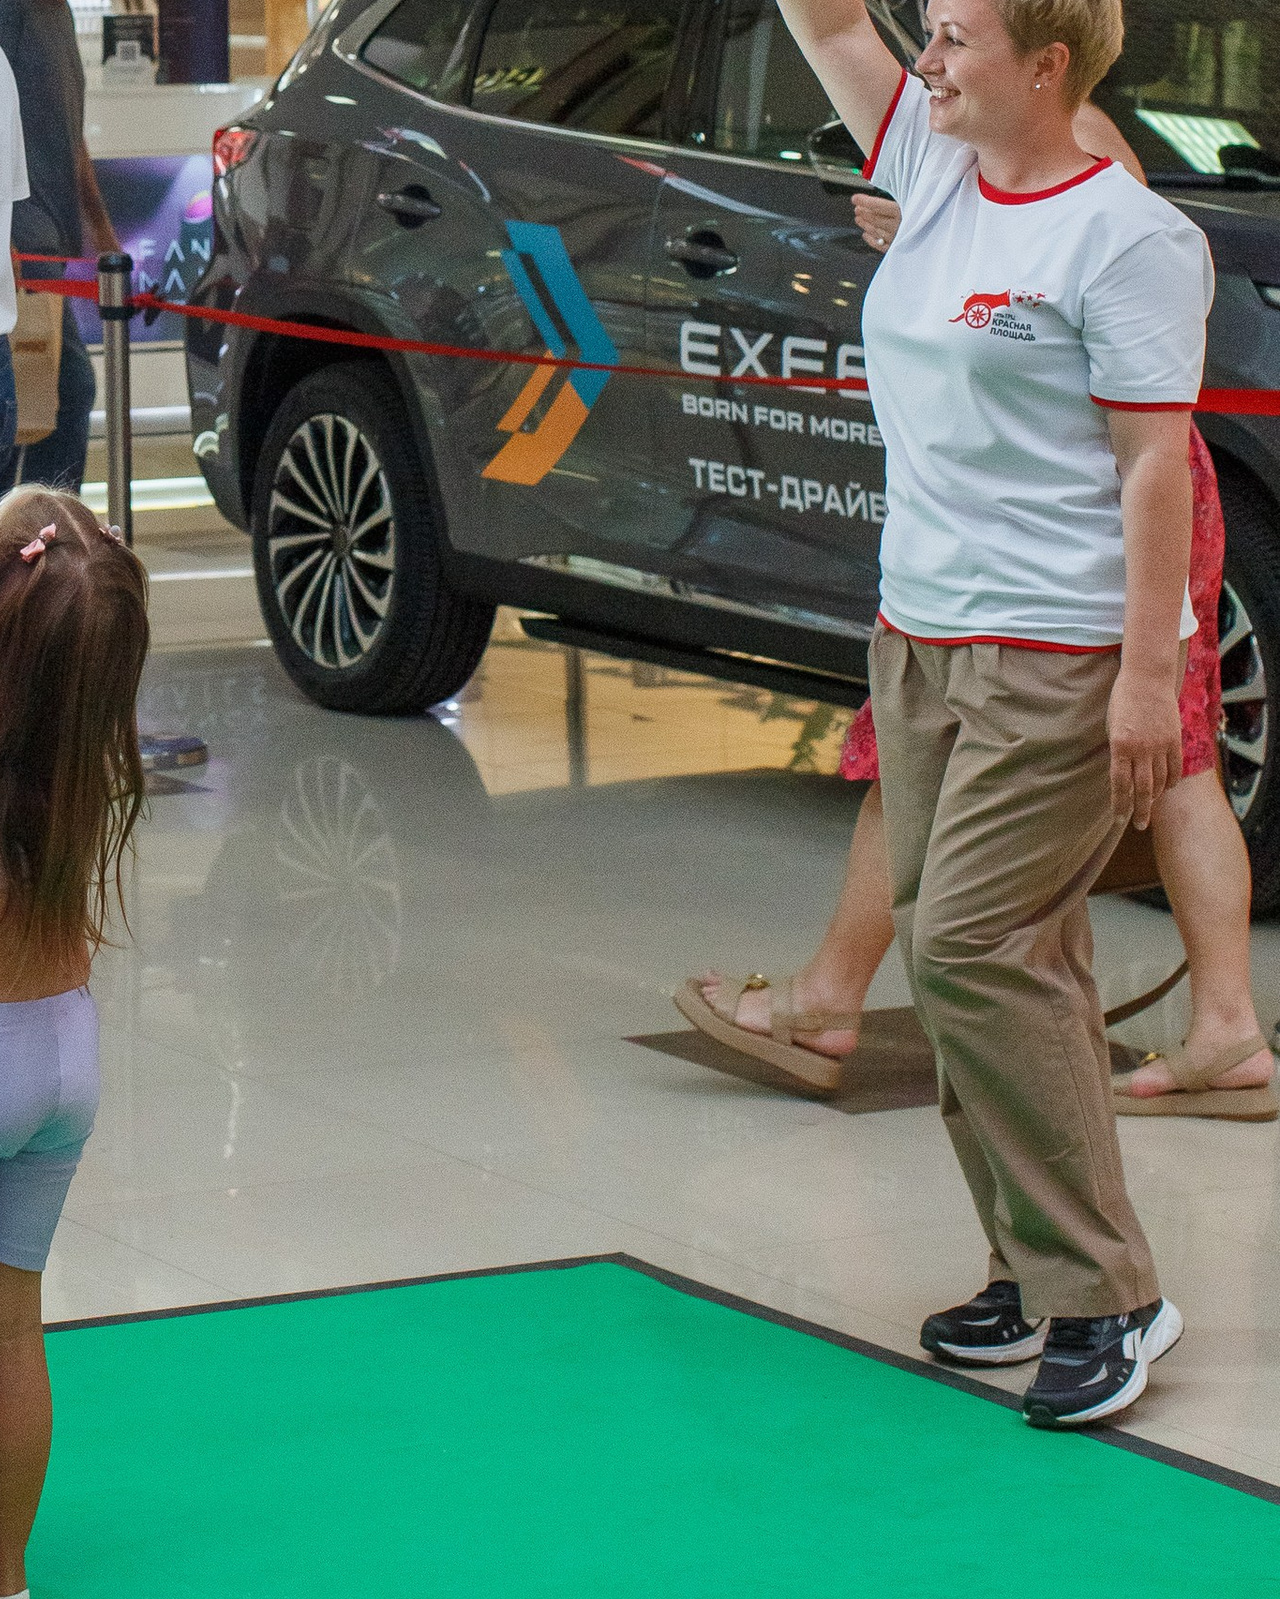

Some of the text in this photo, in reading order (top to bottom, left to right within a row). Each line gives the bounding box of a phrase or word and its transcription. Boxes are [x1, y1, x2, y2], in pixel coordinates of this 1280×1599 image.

[991, 318, 1032, 331] КРАСНАЯ
[989, 327, 1036, 342] ПЛОЩАДЬ
[681, 393, 883, 447] BORN FOR MORE
